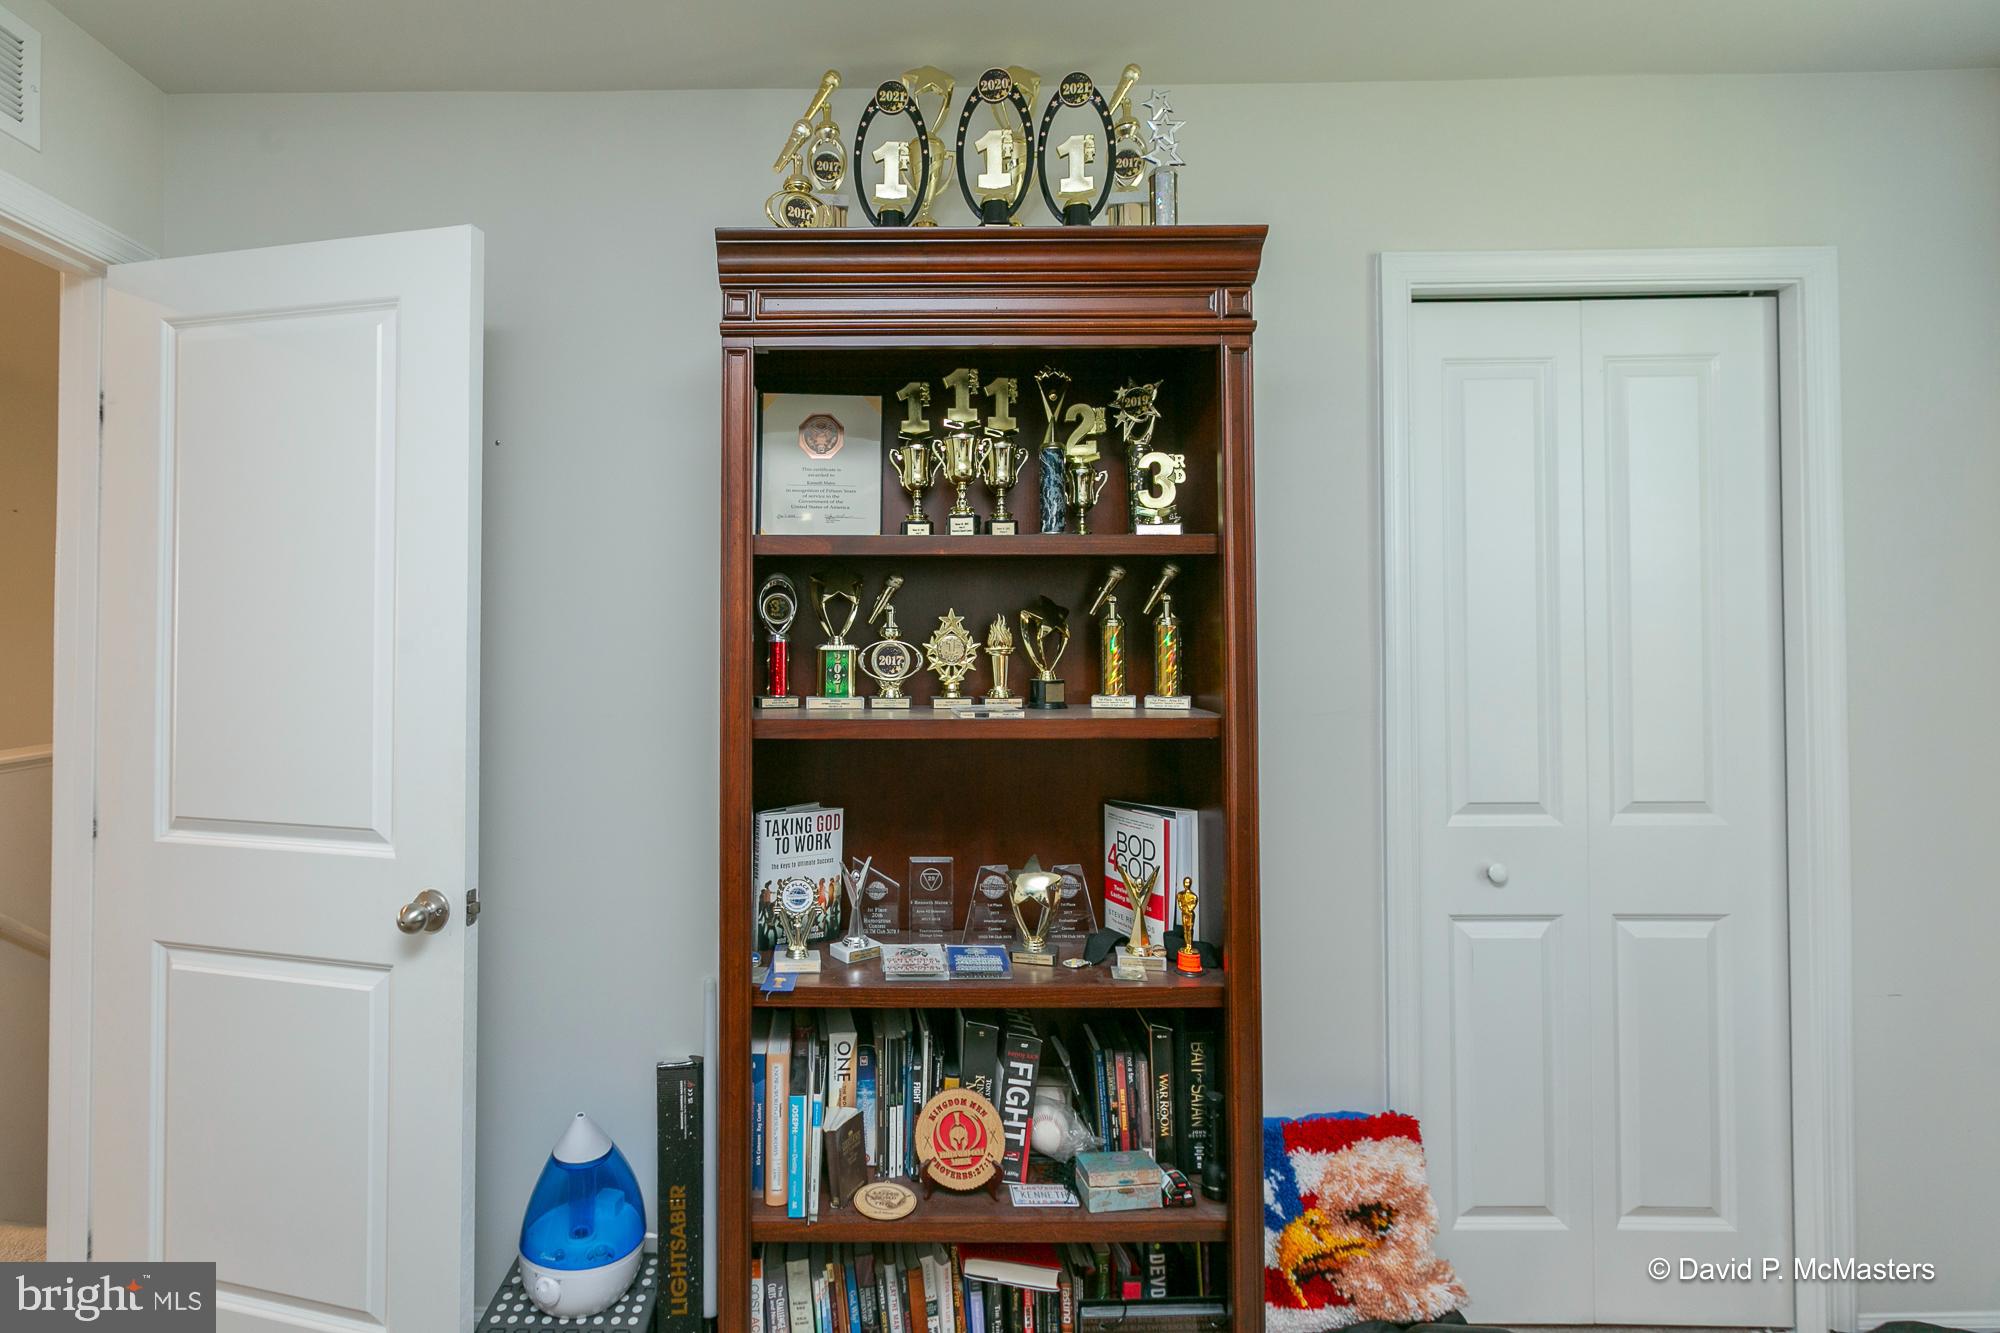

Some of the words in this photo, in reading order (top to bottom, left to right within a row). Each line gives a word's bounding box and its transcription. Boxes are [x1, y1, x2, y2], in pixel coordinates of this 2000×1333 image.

[879, 90, 905, 102] 2021
[980, 79, 1009, 91] 2020
[1062, 83, 1091, 95] 2021
[816, 160, 839, 172] 2017
[1116, 157, 1140, 169] 2017
[787, 205, 813, 221] 2017
[1124, 395, 1149, 408] 2019
[834, 652, 842, 694] 2021
[878, 655, 904, 667] 2017
[764, 816, 812, 838] TAKING
[816, 813, 841, 833] GOD
[775, 837, 790, 855] TO
[794, 833, 832, 852] WORK
[1116, 831, 1156, 861] BOD
[1107, 843, 1118, 872] 4
[1116, 852, 1155, 882] GOD
[836, 1041, 852, 1082] ONE
[1190, 1041, 1206, 1073] BAIT
[913, 1082, 922, 1104] FIGHT
[985, 1078, 993, 1097] TONY
[1159, 1073, 1169, 1099] WAR
[928, 1097, 968, 1122] KINGDOM
[969, 1099, 989, 1119] MEN
[1004, 1061, 1034, 1147] FIGHT
[1191, 1084, 1207, 1127] SATAN
[791, 1103, 799, 1135] JOSEPH:
[1160, 1100, 1170, 1137] ROOM
[669, 1184, 688, 1317] LIGHTSABER
[888, 1280, 897, 1297] PLAY
